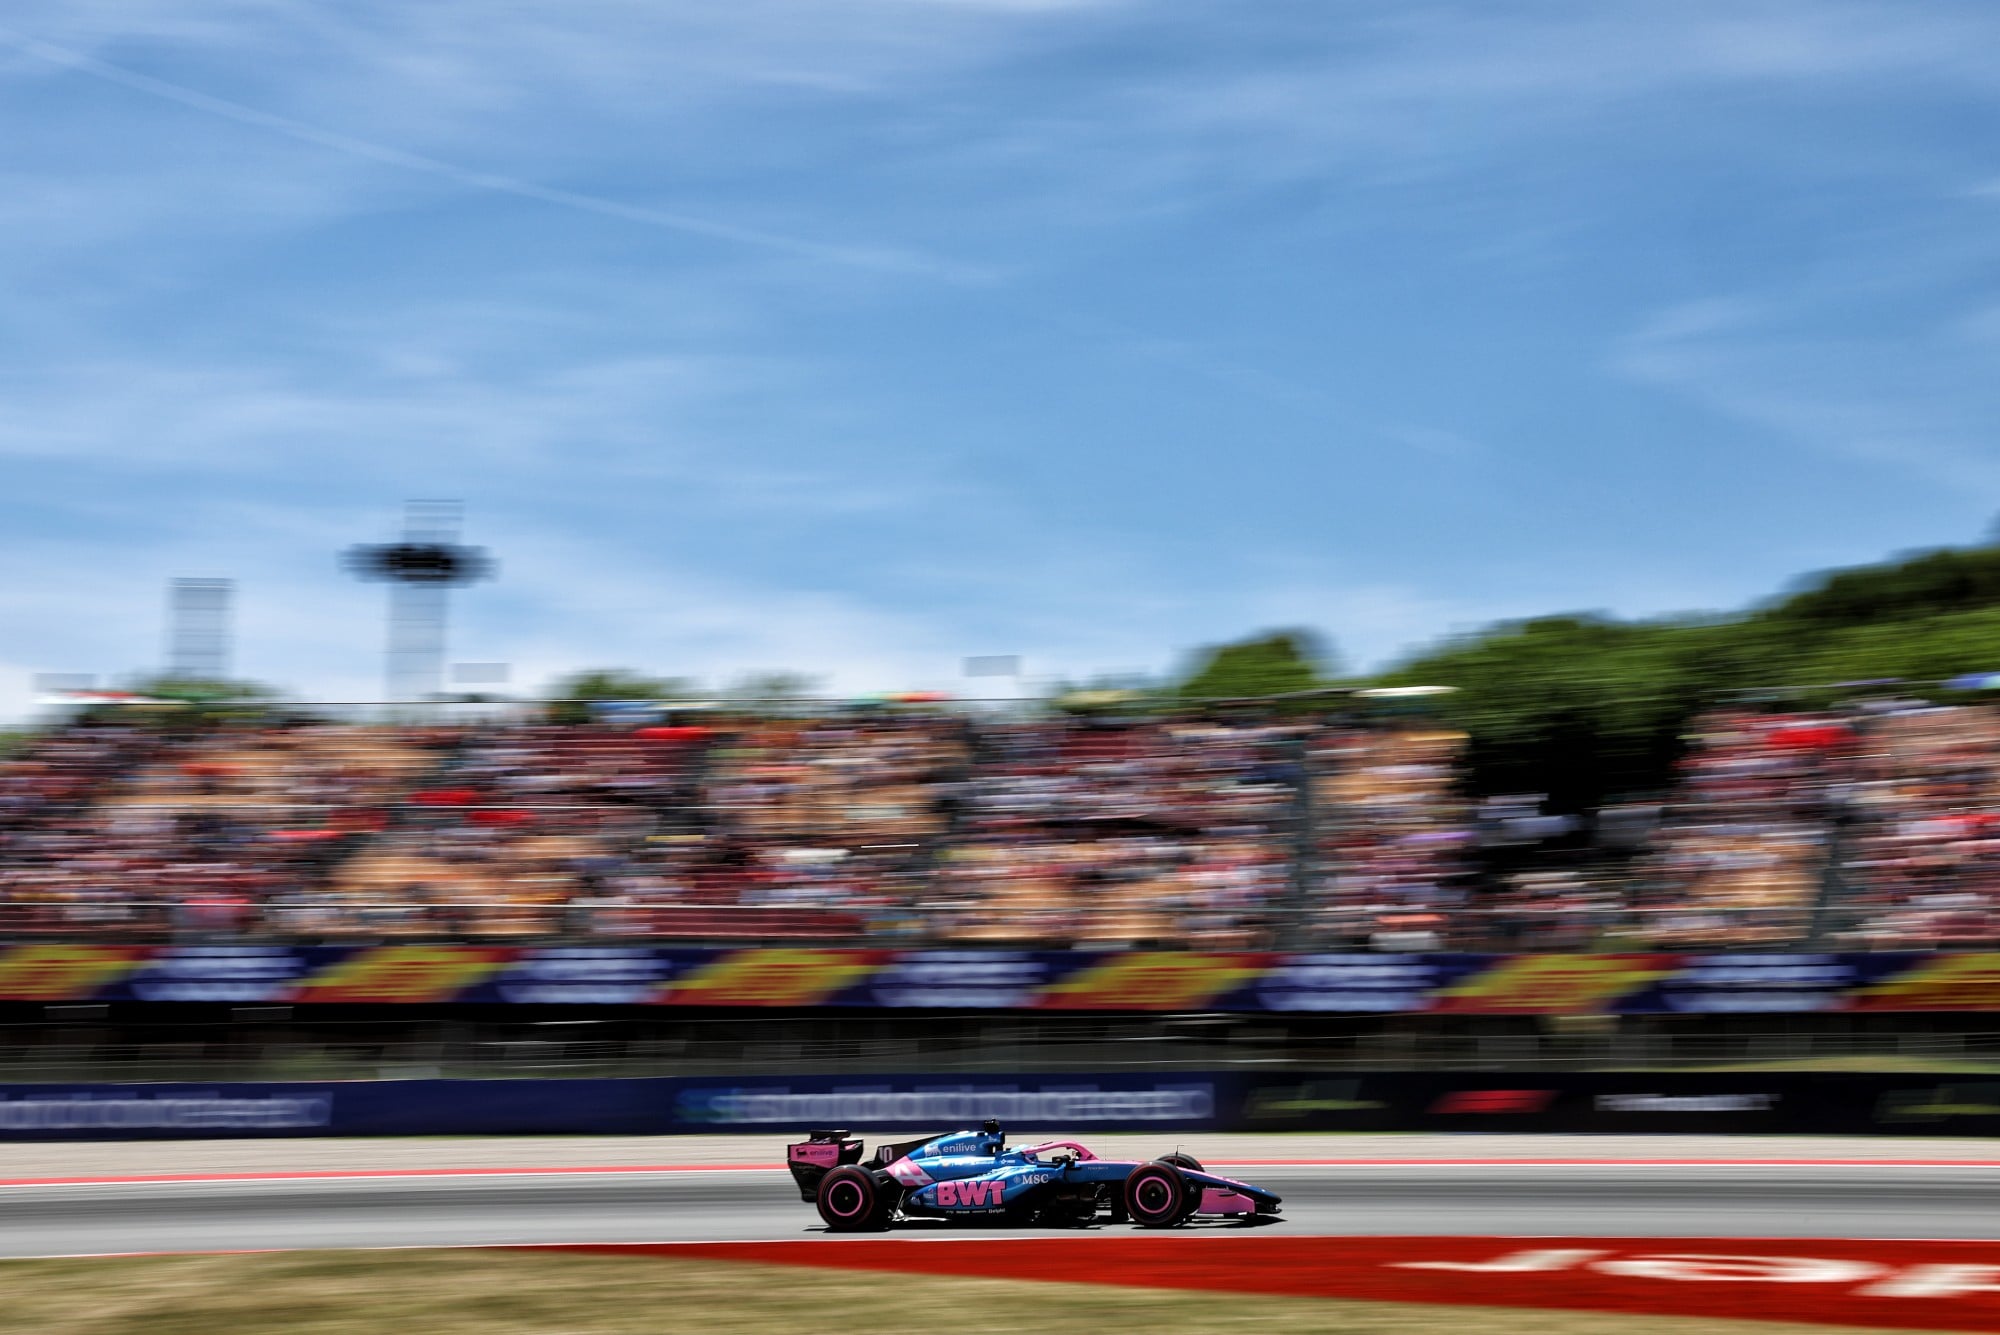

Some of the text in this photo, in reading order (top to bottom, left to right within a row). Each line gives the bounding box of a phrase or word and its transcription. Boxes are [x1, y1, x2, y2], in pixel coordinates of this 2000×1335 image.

[879, 1146, 893, 1163] 10
[943, 1143, 977, 1153] enilive
[1021, 1173, 1049, 1185] MSC
[937, 1180, 1006, 1206] BWT
